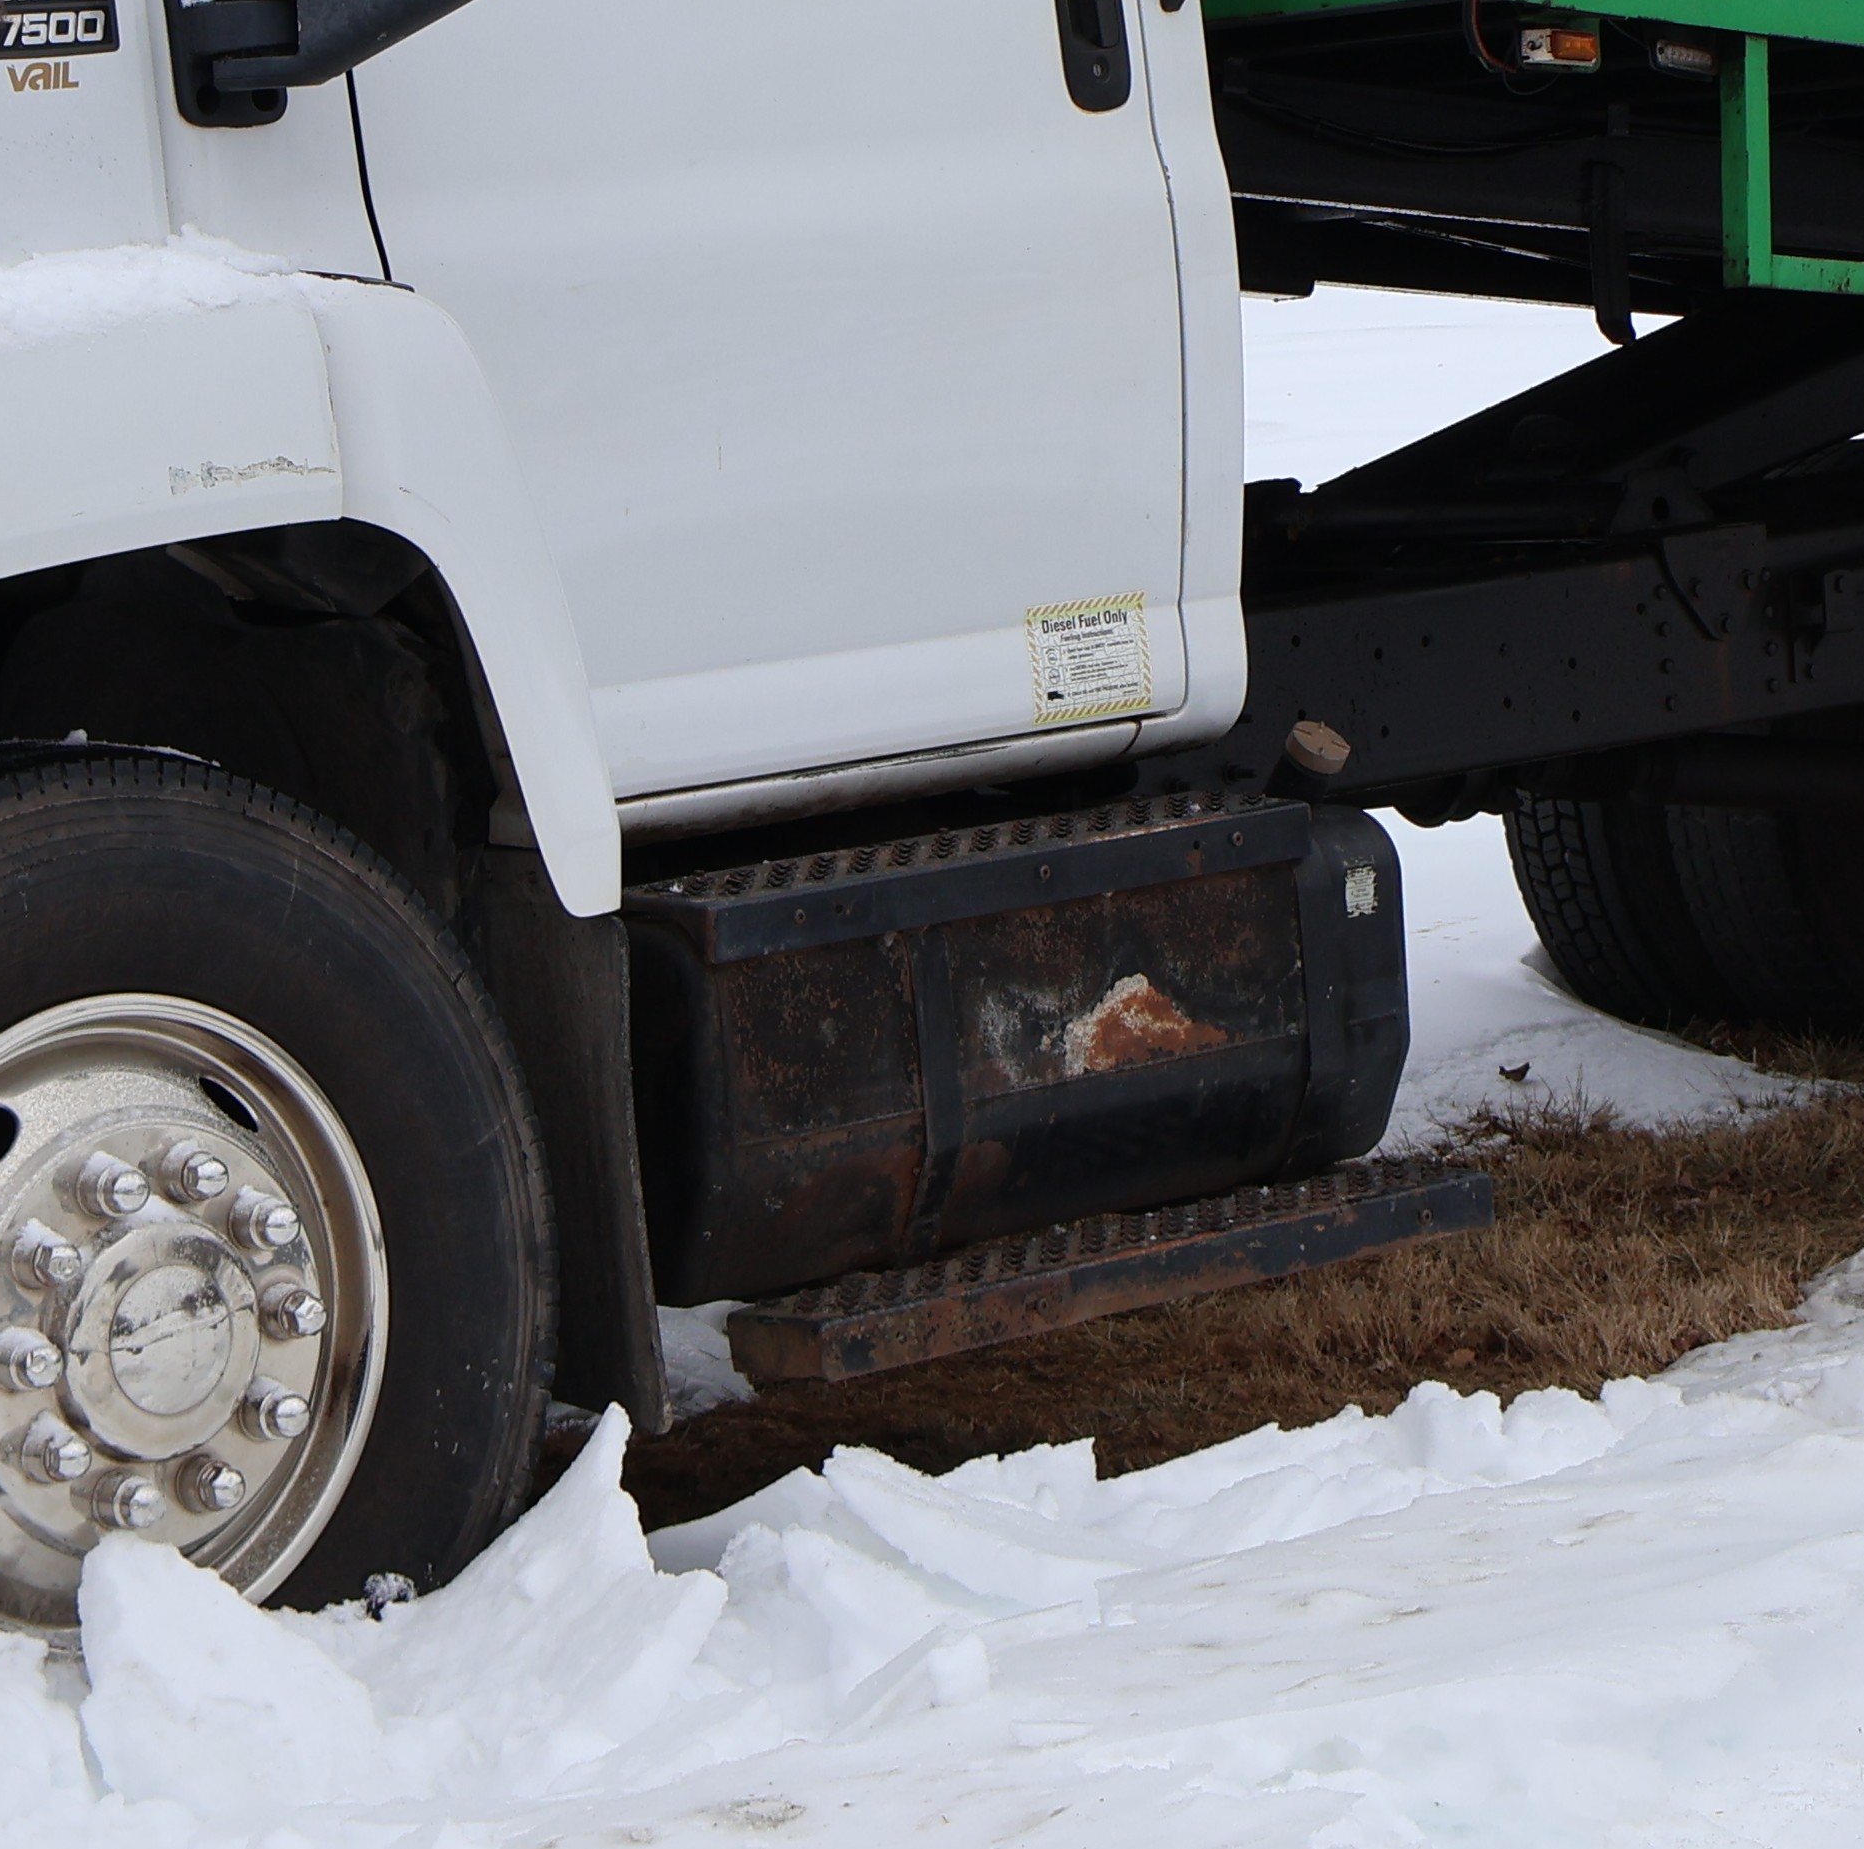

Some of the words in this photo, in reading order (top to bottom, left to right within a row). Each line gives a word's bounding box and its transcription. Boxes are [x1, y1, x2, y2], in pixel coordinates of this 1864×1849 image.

[1041, 616, 1076, 634] Diesel
[1078, 612, 1101, 628] Fuel
[1103, 609, 1127, 625] Only
